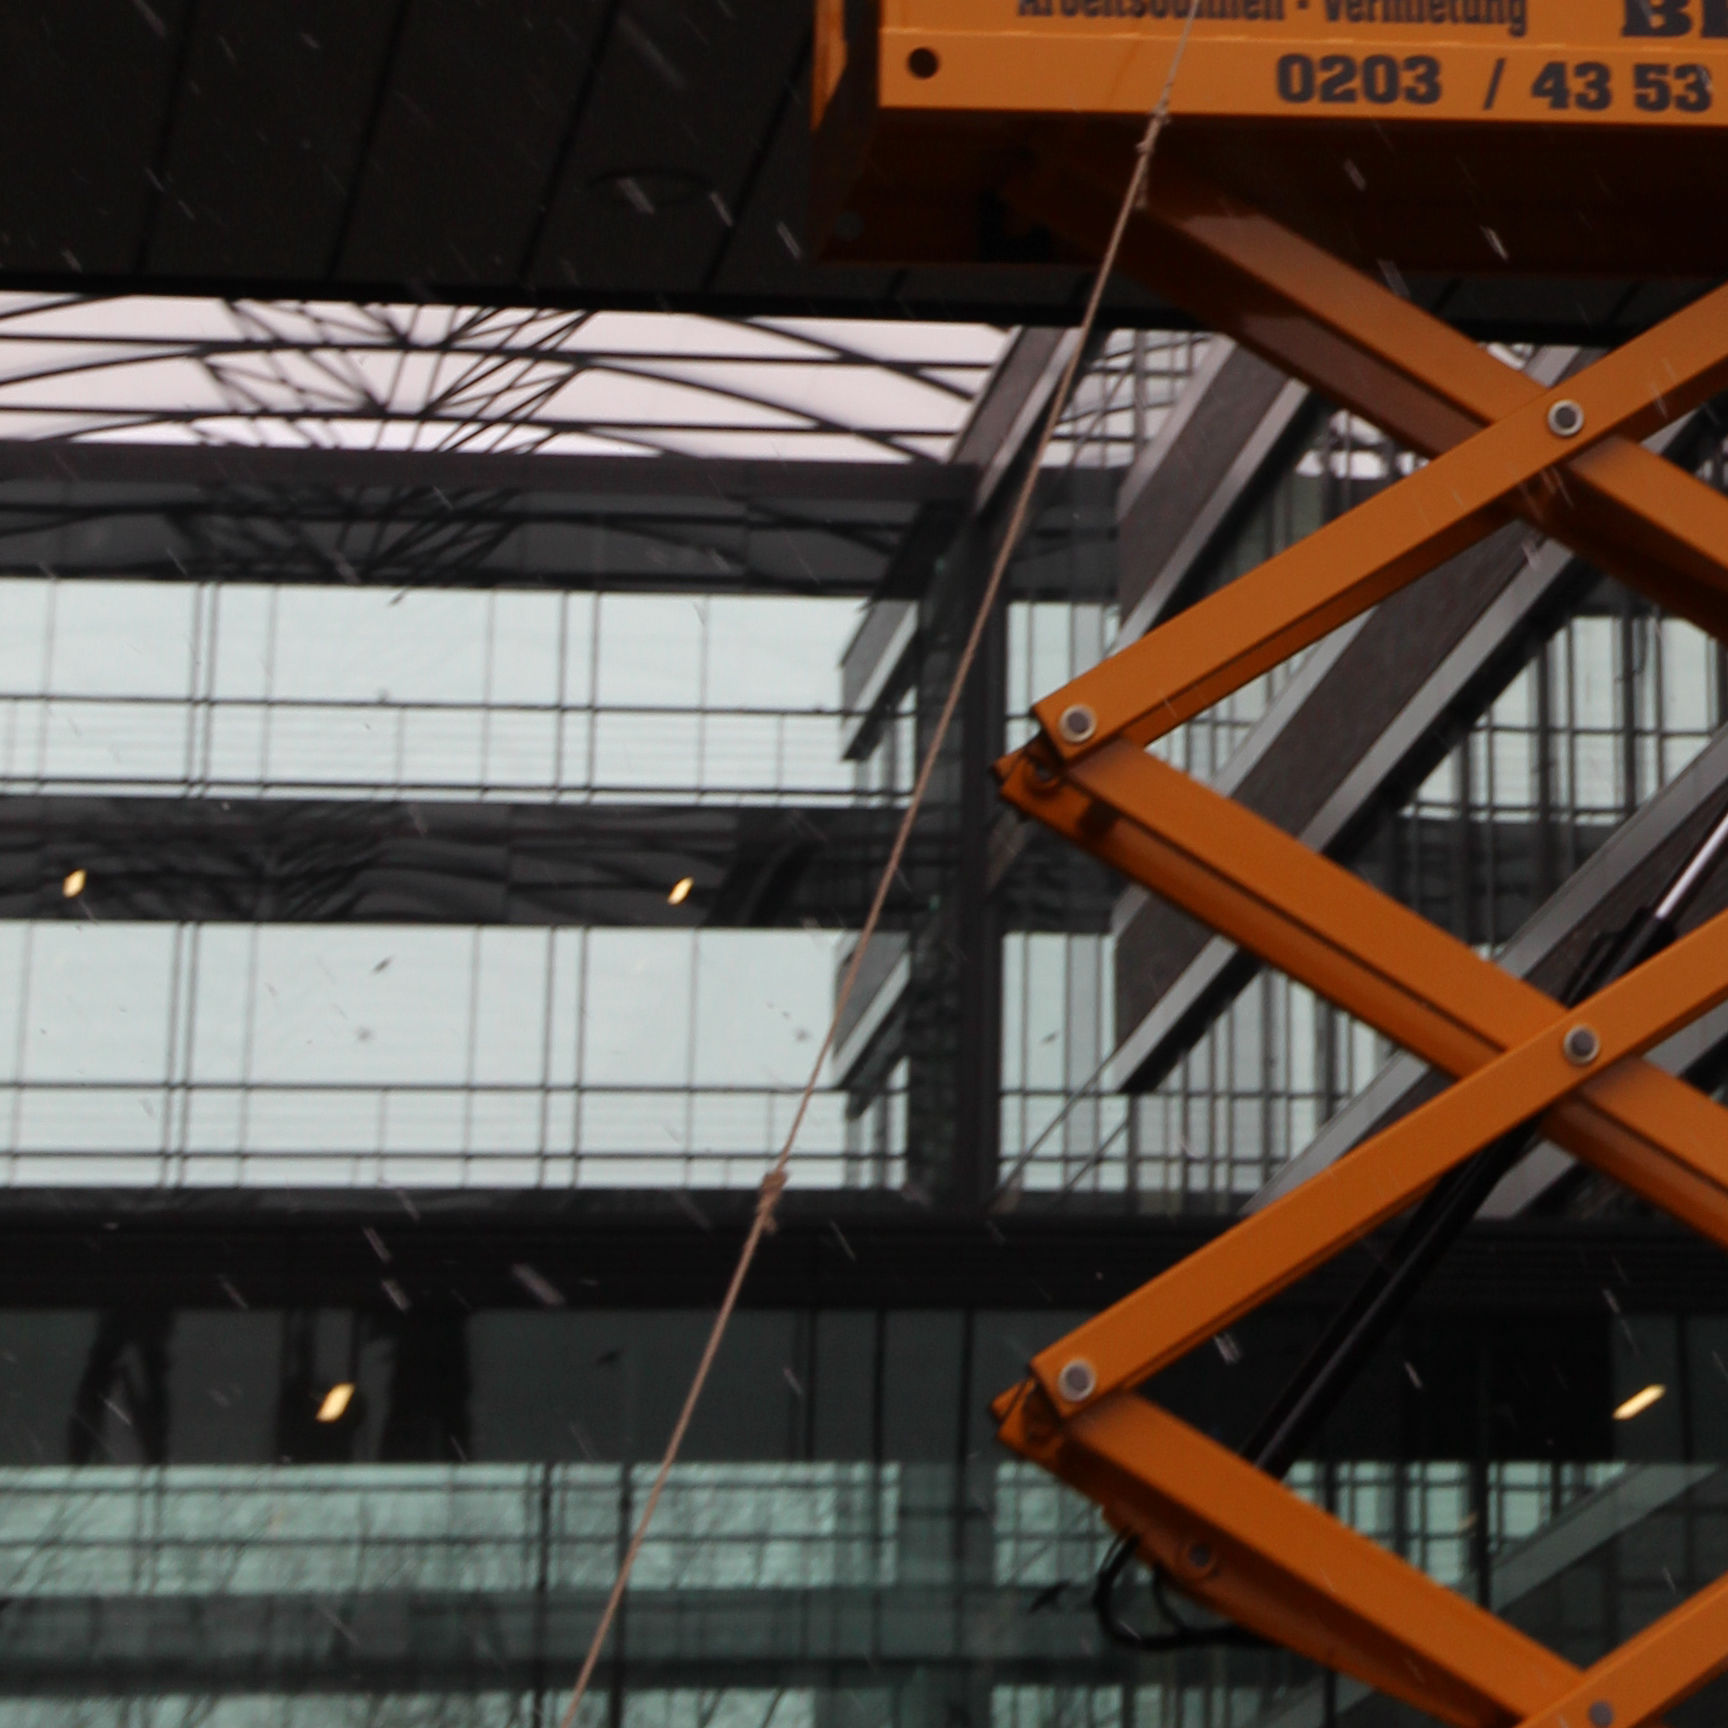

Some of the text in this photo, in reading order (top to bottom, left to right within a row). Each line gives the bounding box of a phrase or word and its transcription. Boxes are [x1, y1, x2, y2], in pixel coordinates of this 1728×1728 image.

[1276, 53, 1441, 105] 0203
[1531, 61, 1611, 110] 43
[1633, 63, 1711, 112] 53
